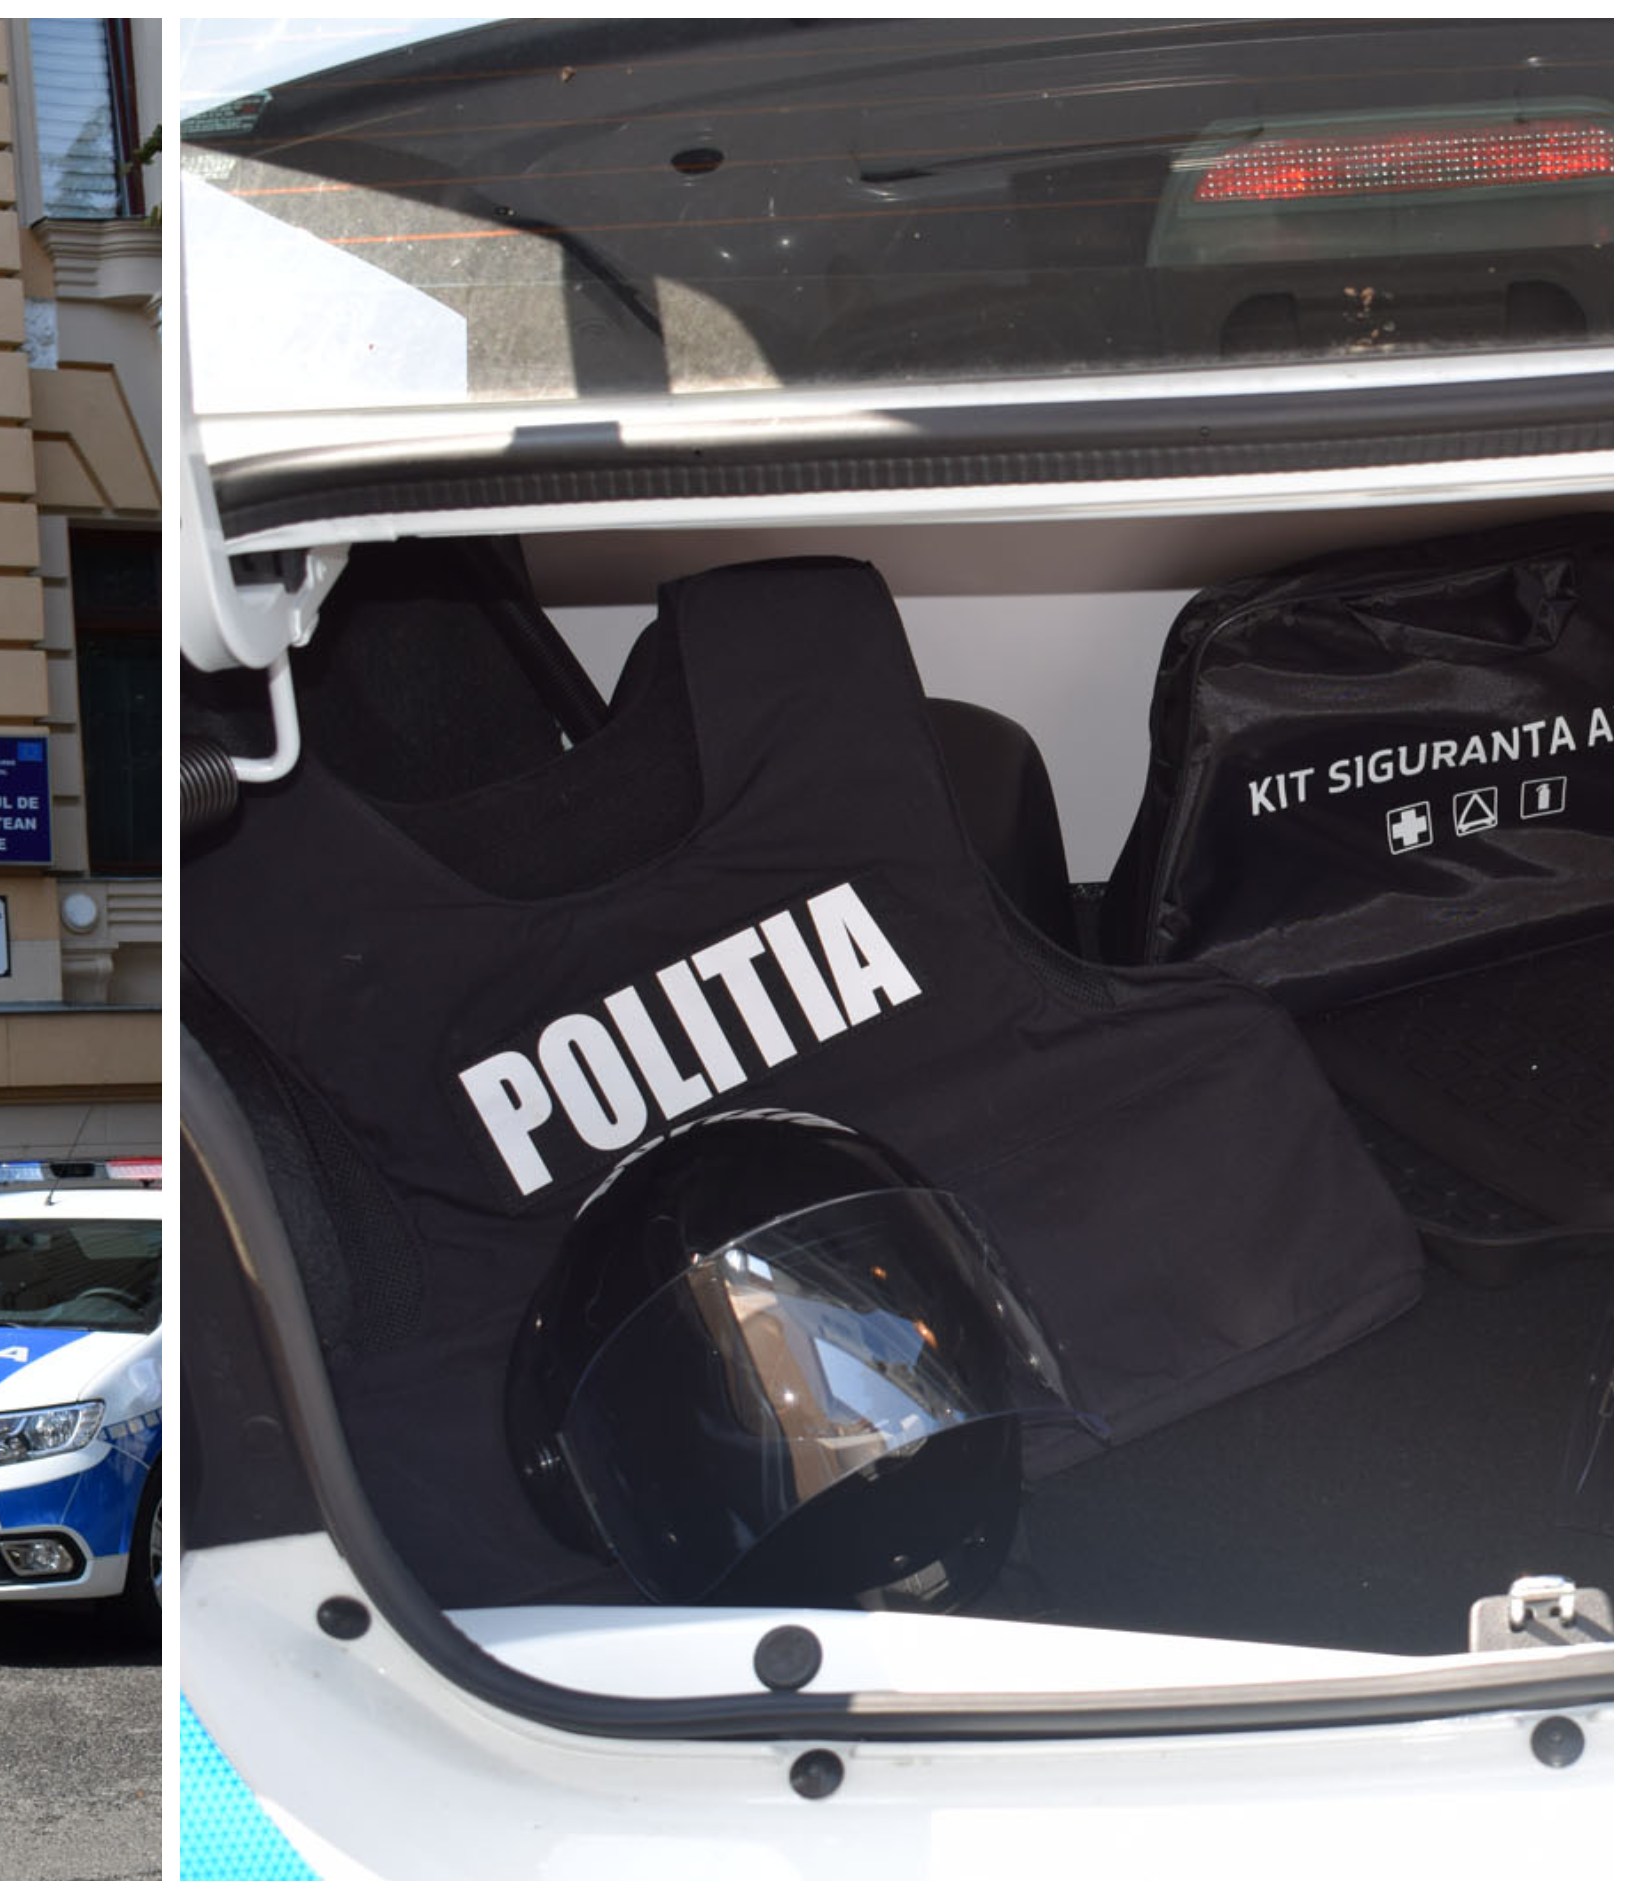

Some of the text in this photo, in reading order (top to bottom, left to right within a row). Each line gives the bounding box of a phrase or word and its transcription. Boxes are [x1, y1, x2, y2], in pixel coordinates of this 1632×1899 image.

[17, 797, 40, 810] DE
[1248, 766, 1315, 816] KIT
[1327, 715, 1576, 794] SIGURANTA
[458, 882, 923, 1196] POLITIA
